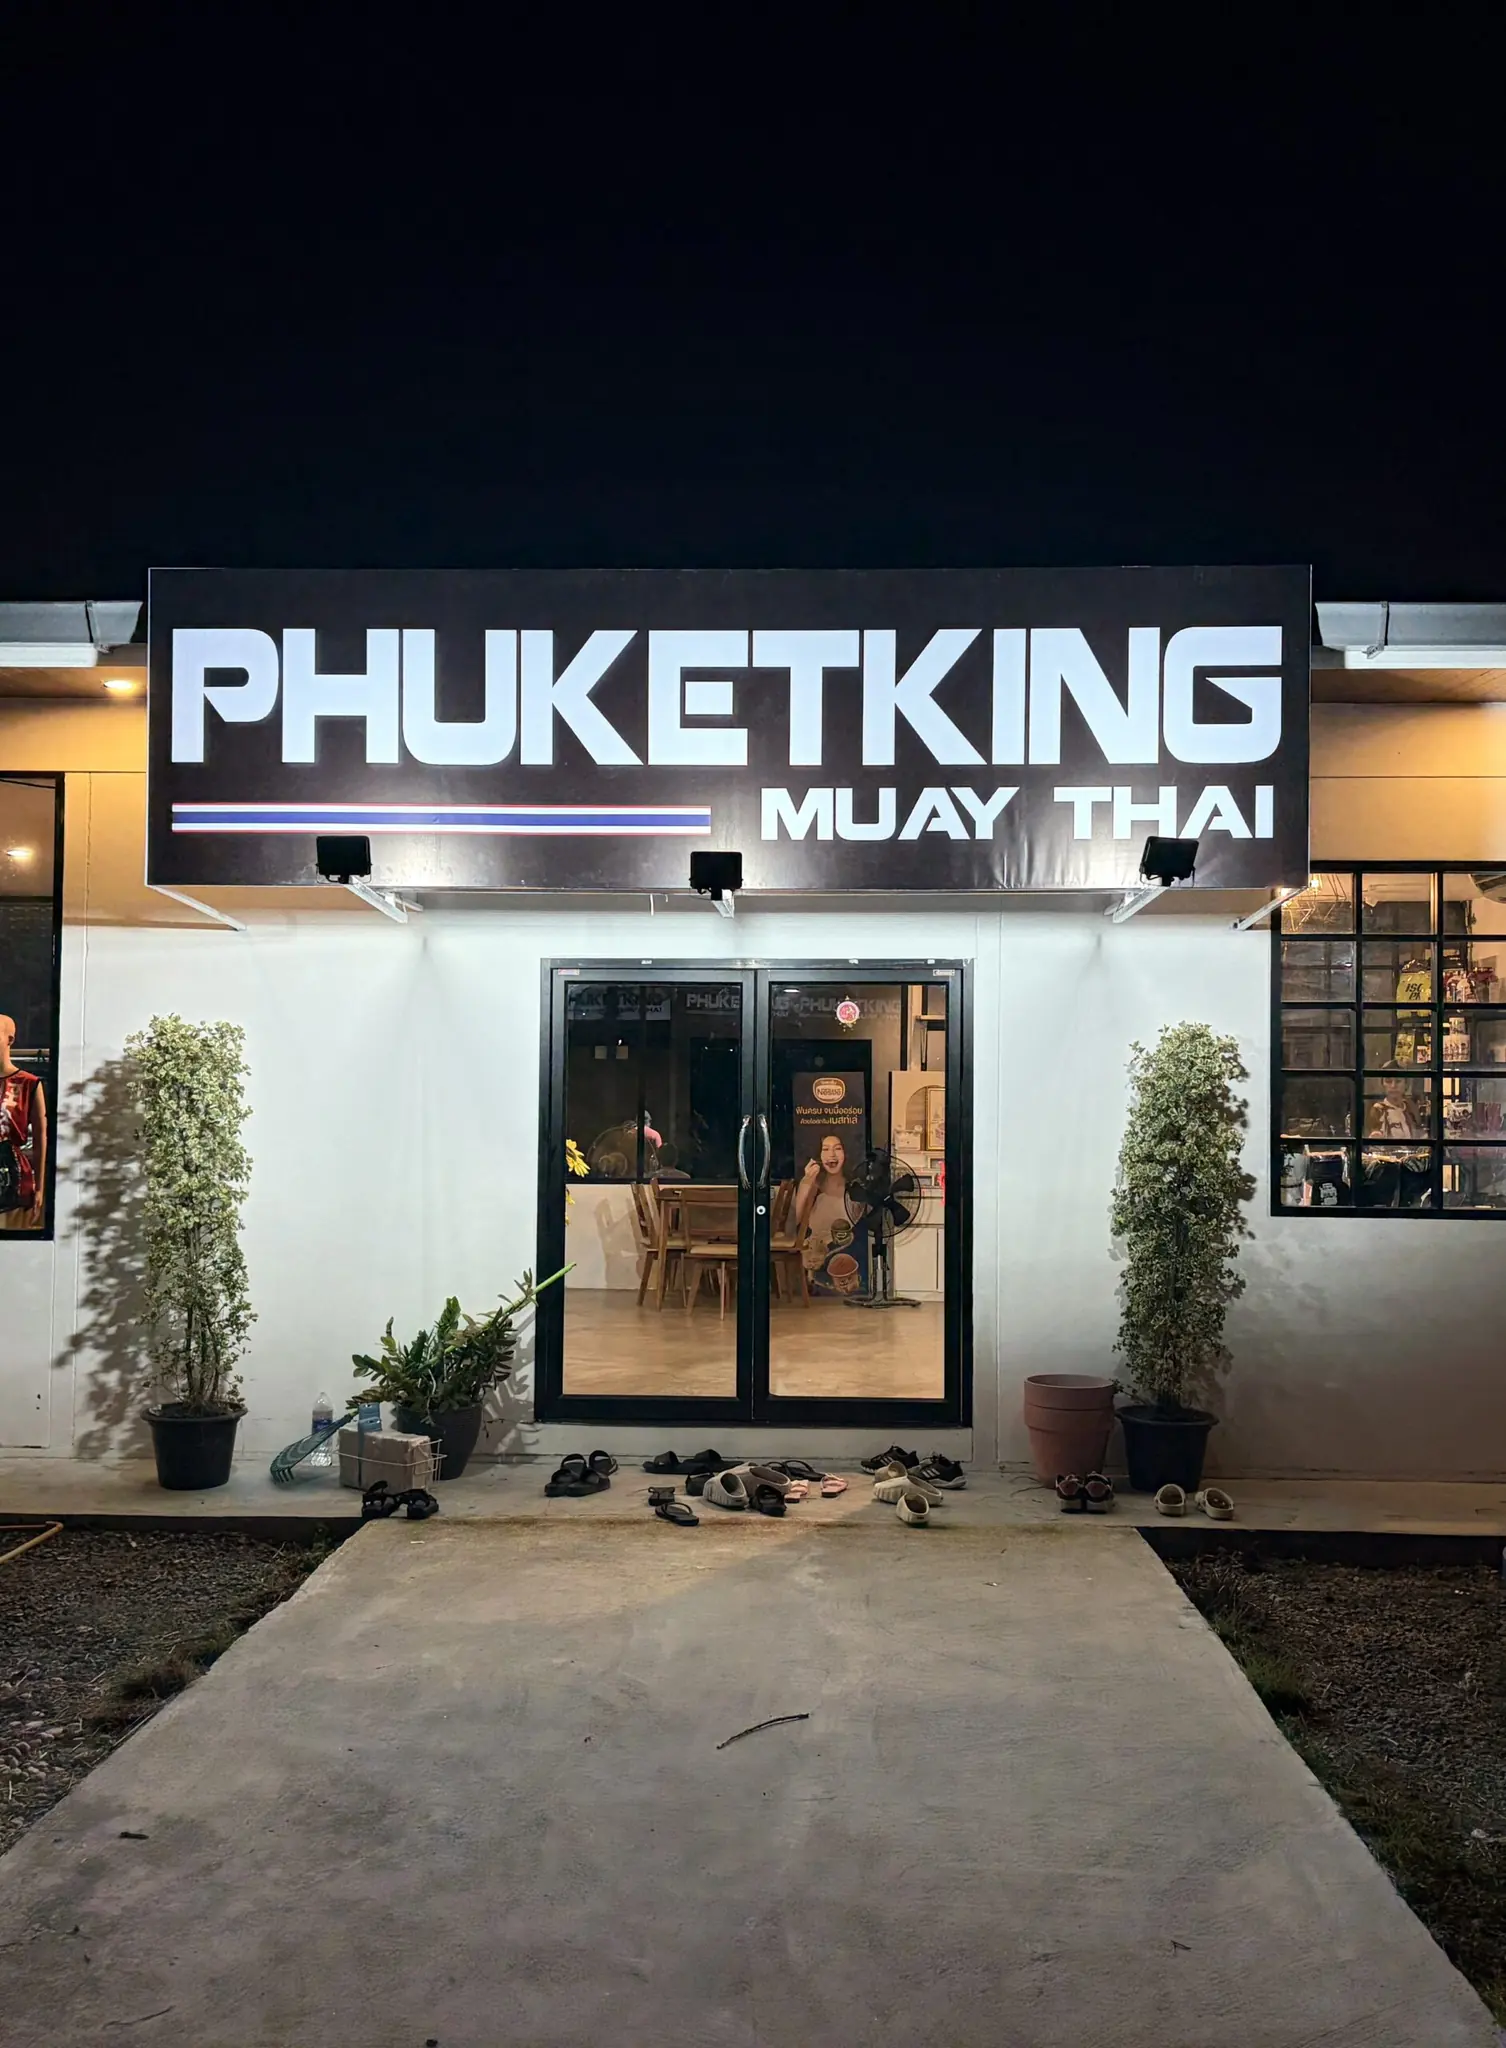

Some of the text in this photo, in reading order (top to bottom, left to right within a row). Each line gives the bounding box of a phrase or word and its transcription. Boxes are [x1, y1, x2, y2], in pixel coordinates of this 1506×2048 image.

[171, 626, 1283, 766] PHUKETKING
[760, 785, 1274, 841] MUAY THAI
